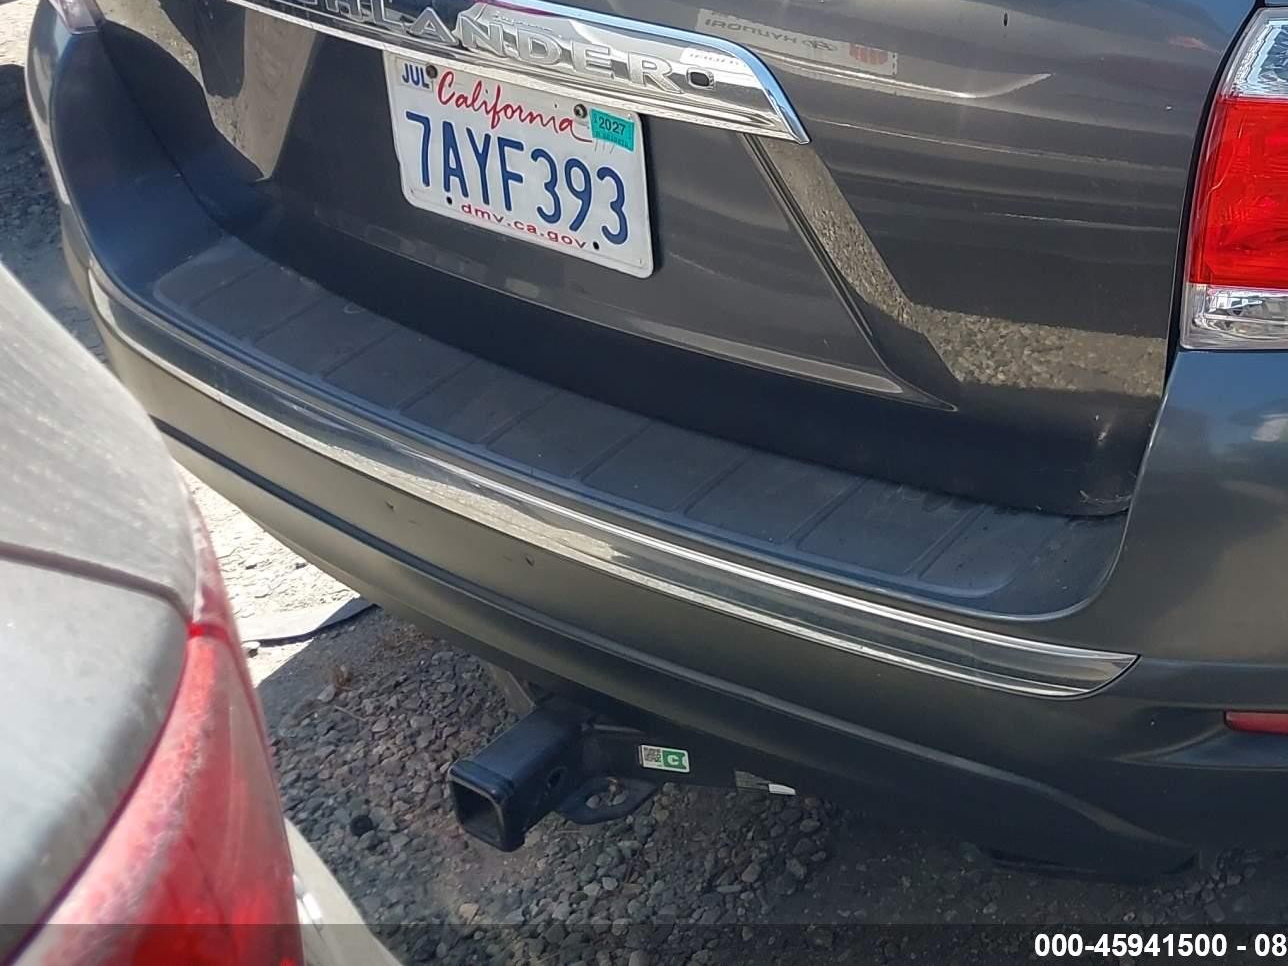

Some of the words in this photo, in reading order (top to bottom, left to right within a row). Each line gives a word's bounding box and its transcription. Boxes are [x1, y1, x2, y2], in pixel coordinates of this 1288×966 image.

[402, 63, 430, 89] JUL
[437, 70, 593, 142] California
[598, 116, 626, 136] 2027
[405, 110, 629, 245] 7AYF393
[461, 203, 587, 250] dmv.ca.gov
